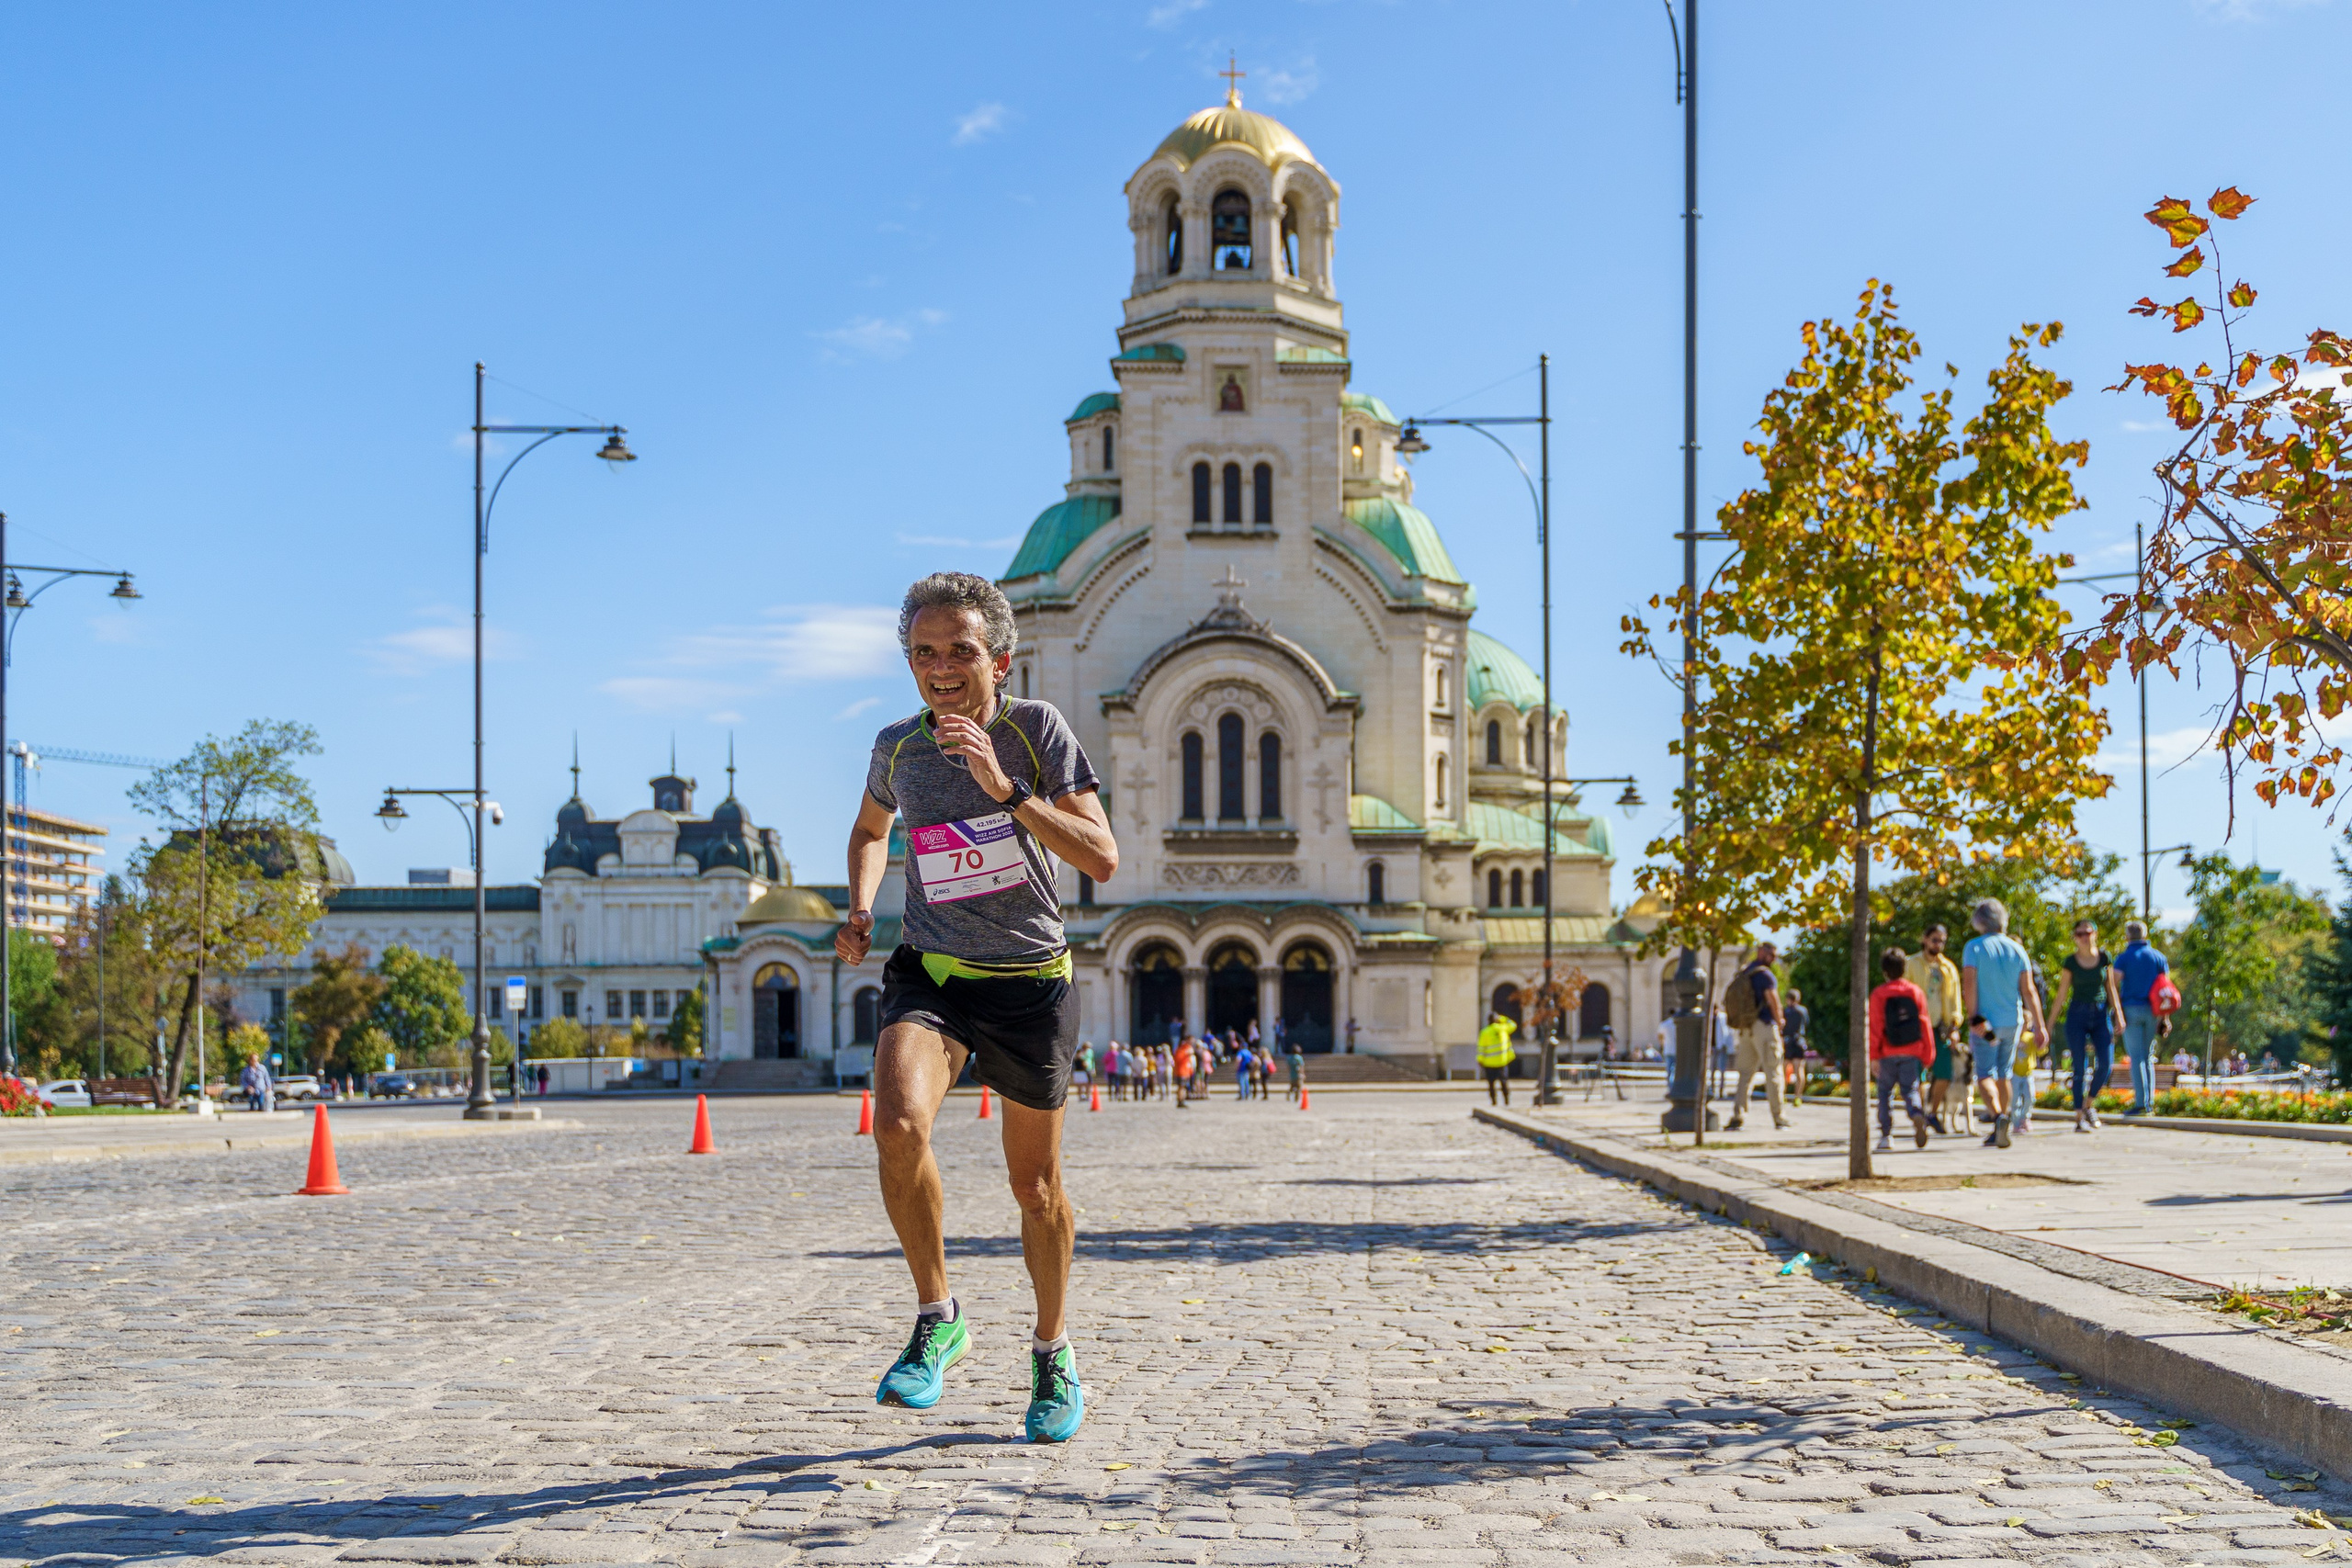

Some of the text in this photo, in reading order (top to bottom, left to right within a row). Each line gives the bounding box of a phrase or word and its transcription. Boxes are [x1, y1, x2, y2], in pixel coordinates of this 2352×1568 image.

[977, 818, 997, 828] 42.195
[976, 834, 1002, 843] MARATHON
[948, 850, 983, 874] 70
